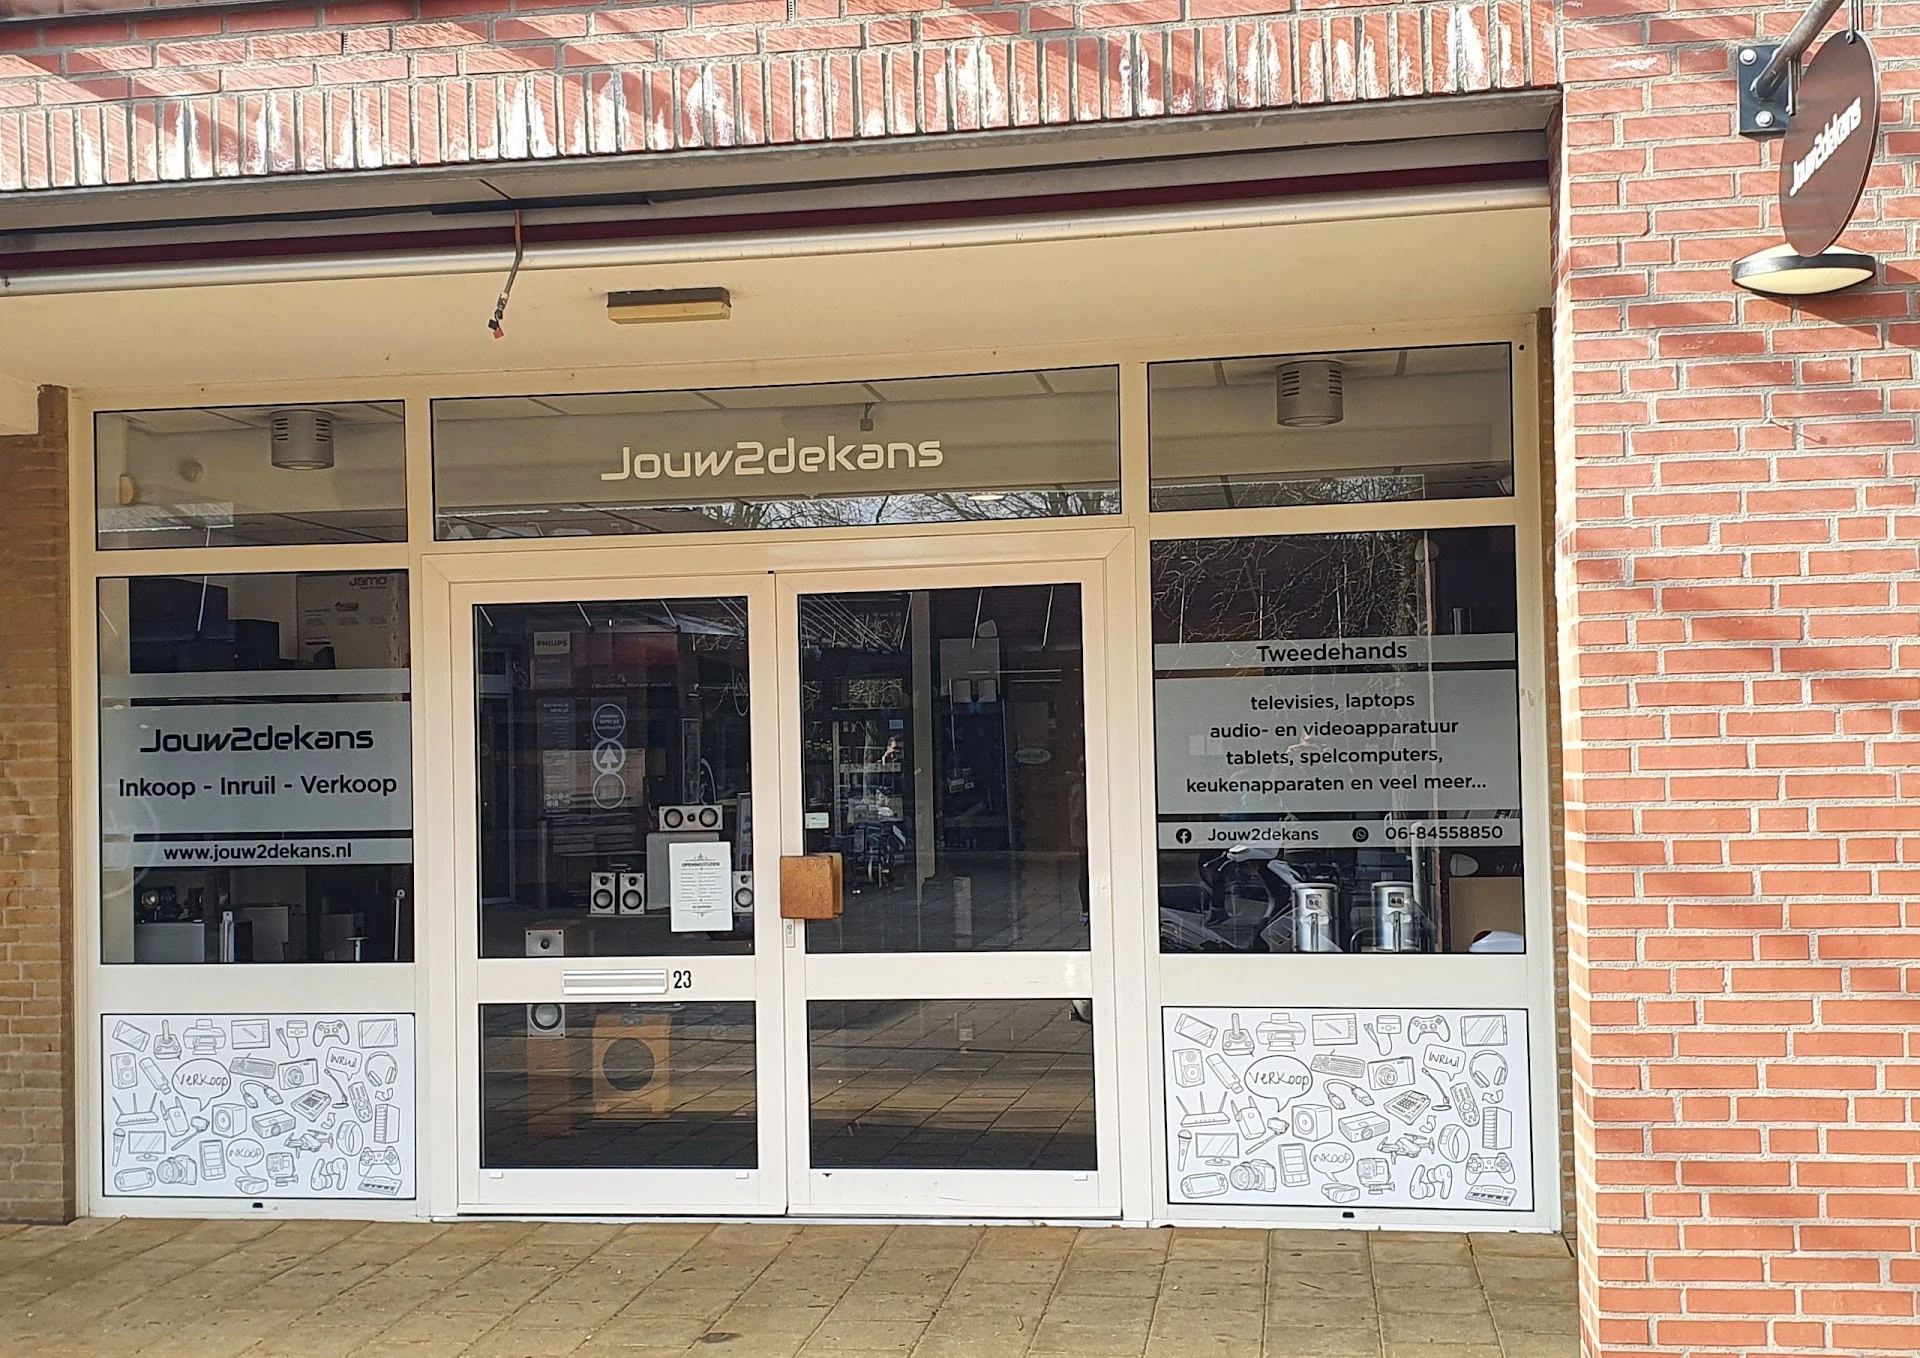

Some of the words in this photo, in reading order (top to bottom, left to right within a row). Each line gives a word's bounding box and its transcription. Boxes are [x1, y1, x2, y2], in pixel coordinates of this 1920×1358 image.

[600, 435, 944, 481] Jouw2dekans
[1256, 641, 1408, 664] Tweedehands
[1250, 694, 1340, 712] televisies,
[1345, 692, 1416, 712] laptops
[140, 725, 374, 753] Jouw2dekans
[1209, 722, 1269, 739] audio-
[1275, 724, 1298, 738] en
[1303, 720, 1460, 739] videoapparatuur
[1226, 749, 1294, 767] tablets,
[1300, 747, 1444, 766] spelcomputers,
[119, 777, 196, 800] Inkoop
[220, 775, 276, 796] Inruil
[300, 774, 397, 797] Verkoop
[1186, 777, 1345, 795] keukenapparaten
[1350, 778, 1373, 791] en
[1379, 775, 1418, 790] veel
[1424, 775, 1487, 790] meer...
[1207, 827, 1320, 843] Jouw2dekans
[1385, 825, 1504, 841] 06-84558850
[163, 843, 352, 863] www.jouw2dekans.nl
[673, 970, 692, 989] 23
